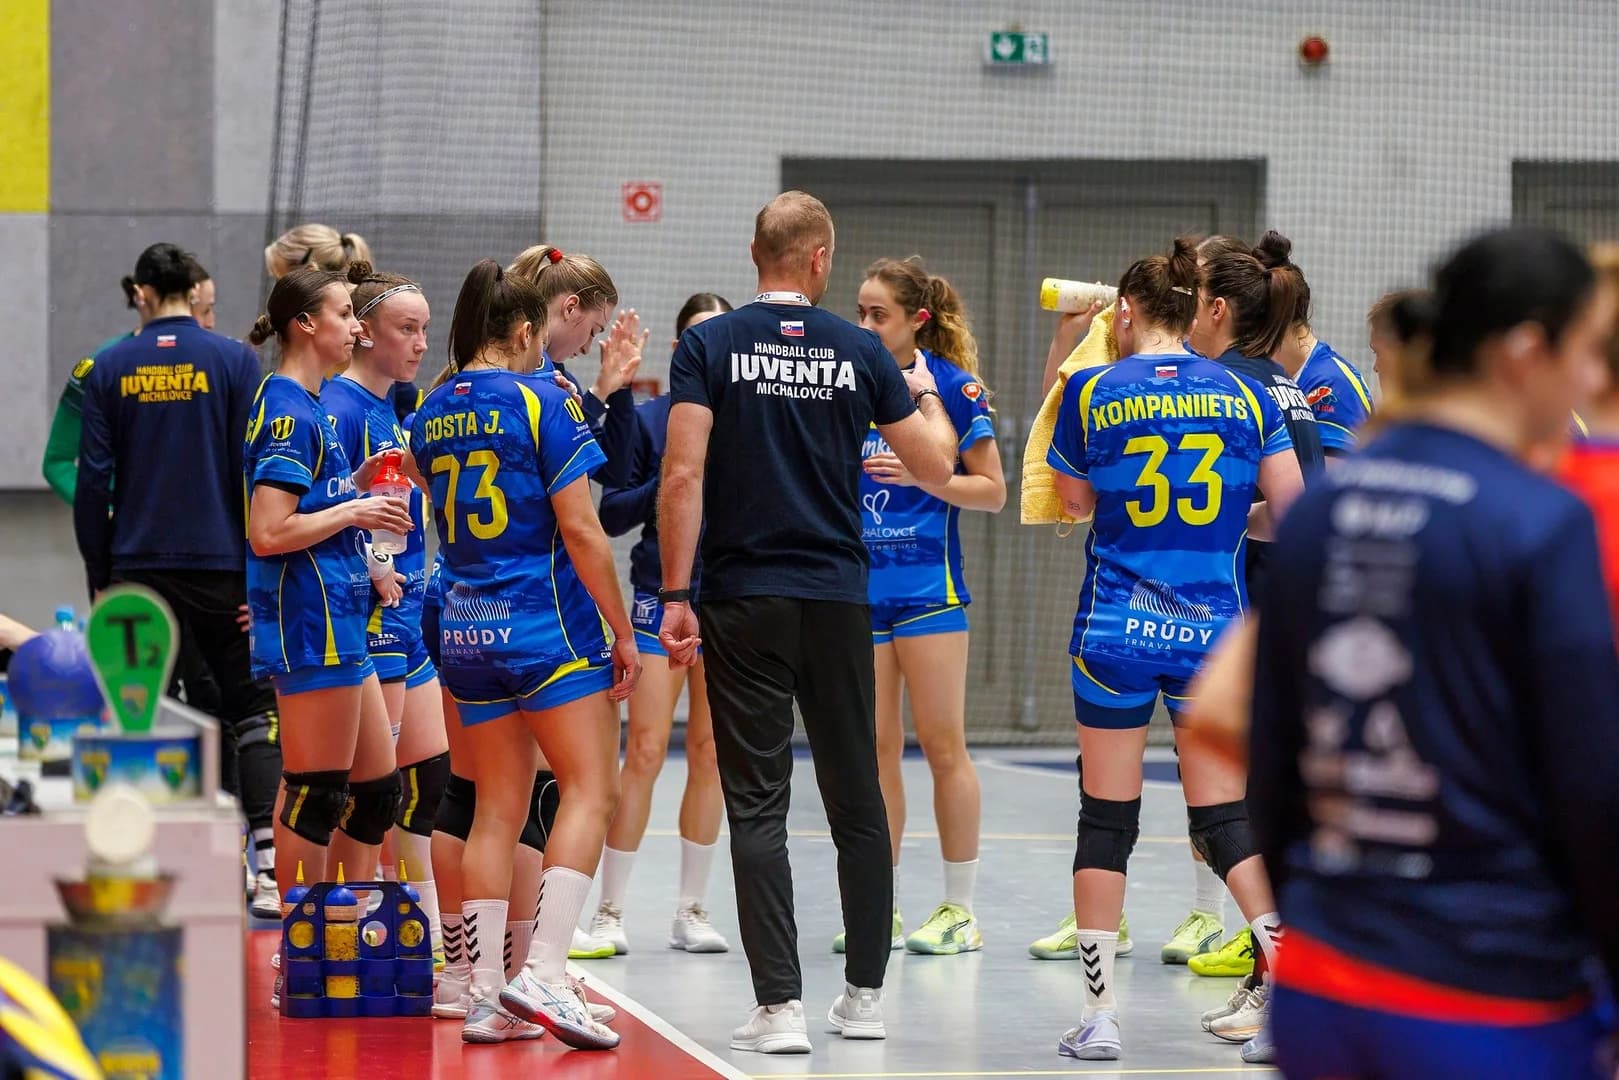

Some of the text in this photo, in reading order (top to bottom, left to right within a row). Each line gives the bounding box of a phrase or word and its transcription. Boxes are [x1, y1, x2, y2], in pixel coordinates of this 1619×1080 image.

[754, 342, 835, 359] HANDBALL CLUB
[136, 363, 194, 376] HANDBALL CLUB
[731, 352, 857, 392] IUVENTA
[121, 371, 209, 398] IUVENTA
[756, 382, 833, 400] MICHALOVCE
[1091, 394, 1248, 431] KOMPANIIETS
[425, 410, 504, 443] COSTA J.
[1123, 433, 1225, 528] 33
[431, 450, 508, 543] 73
[443, 624, 512, 645] PRÚDY
[1124, 638, 1172, 651] TRNAVA
[1125, 618, 1213, 645] PRÚDY
